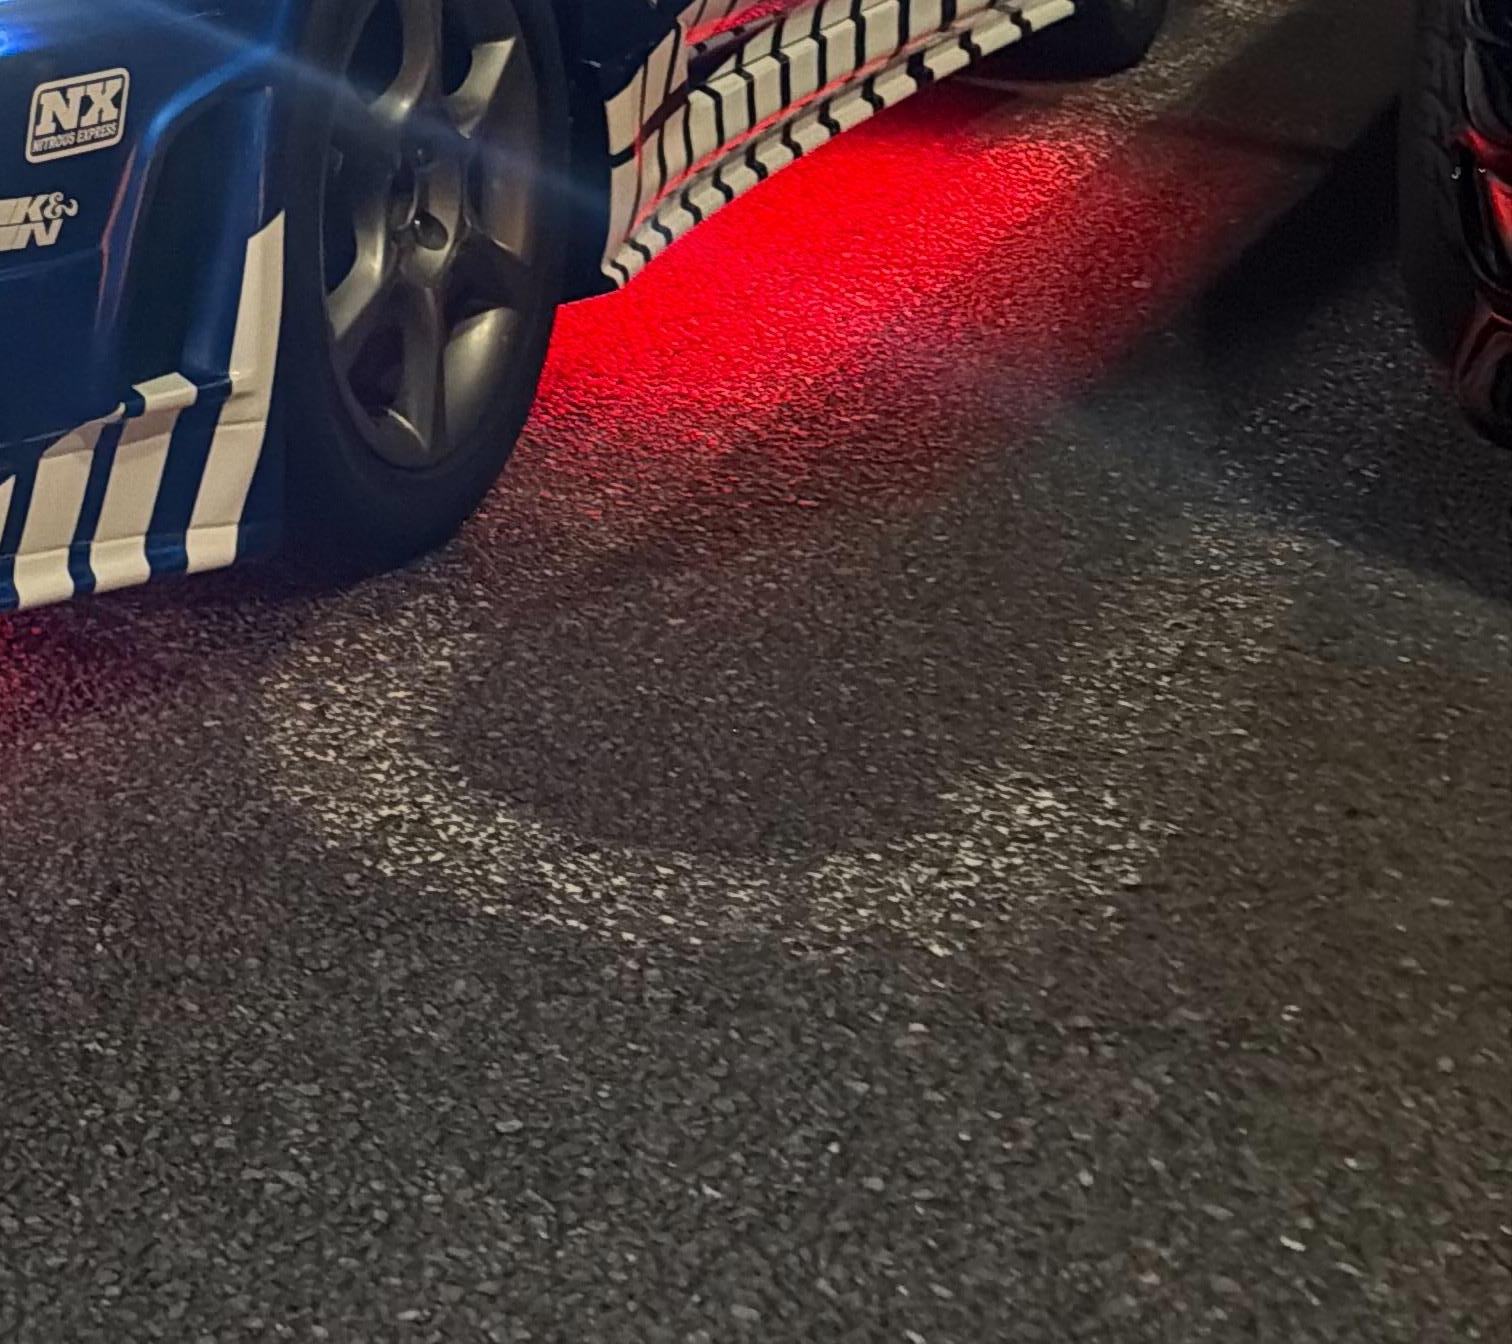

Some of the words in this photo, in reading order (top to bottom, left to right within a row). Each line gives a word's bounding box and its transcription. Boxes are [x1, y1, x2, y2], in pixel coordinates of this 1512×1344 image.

[35, 77, 124, 137] NX
[31, 130, 76, 153] NITROUS
[75, 122, 118, 144] EXPRESS
